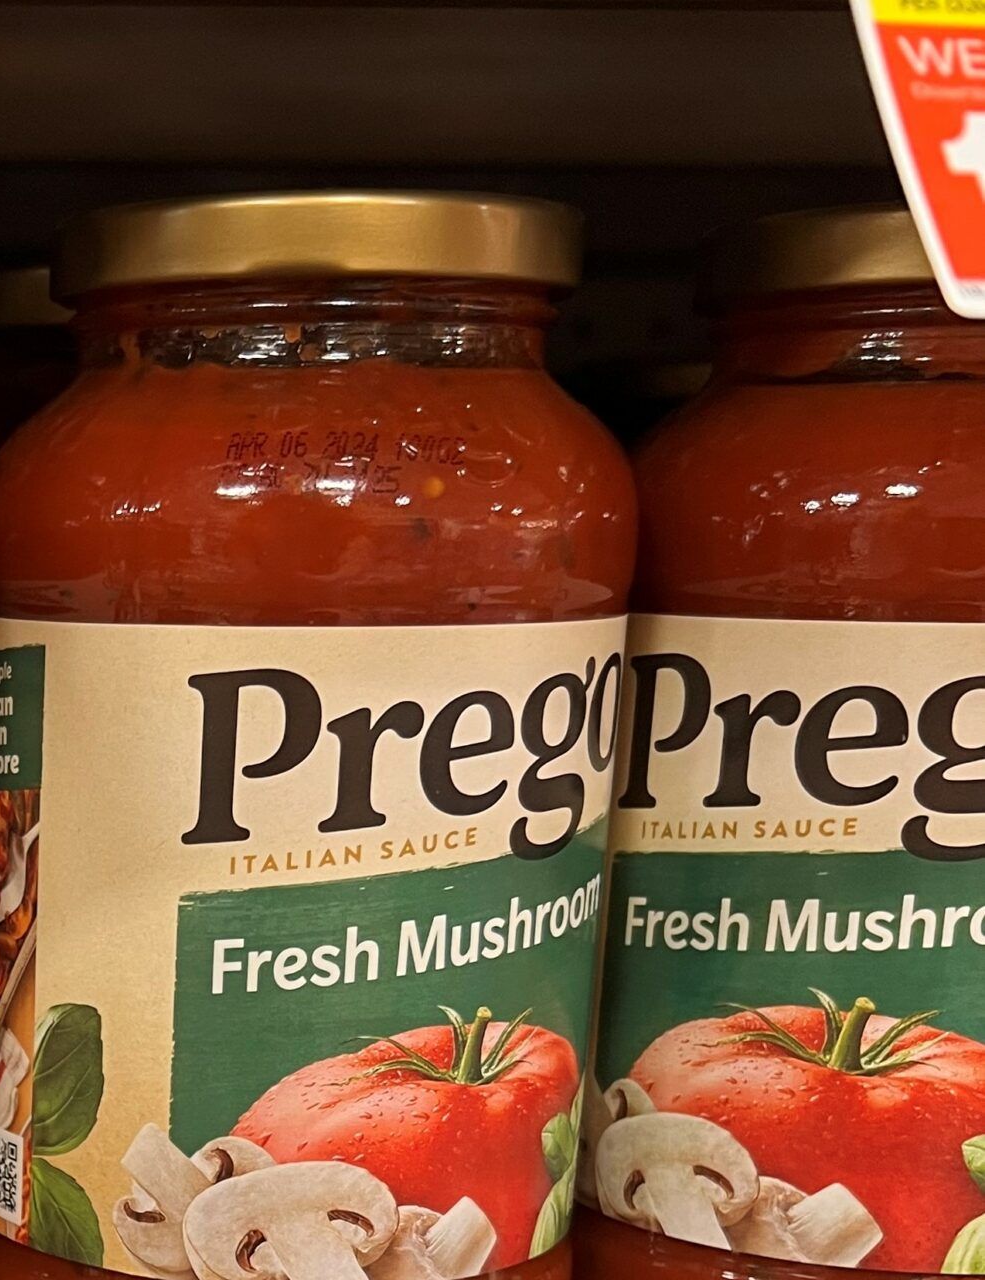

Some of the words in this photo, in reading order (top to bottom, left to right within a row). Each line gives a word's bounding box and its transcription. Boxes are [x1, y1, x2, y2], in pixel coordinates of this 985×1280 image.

[180, 651, 623, 860] Prego
[228, 844, 361, 876] ITALIAN
[380, 827, 479, 860] SAUCE
[641, 818, 740, 842] ITALIAN
[754, 816, 858, 839] SAUCE
[212, 921, 380, 994] Fresh
[395, 871, 602, 977] Mushroom
[624, 896, 749, 952] Fresh
